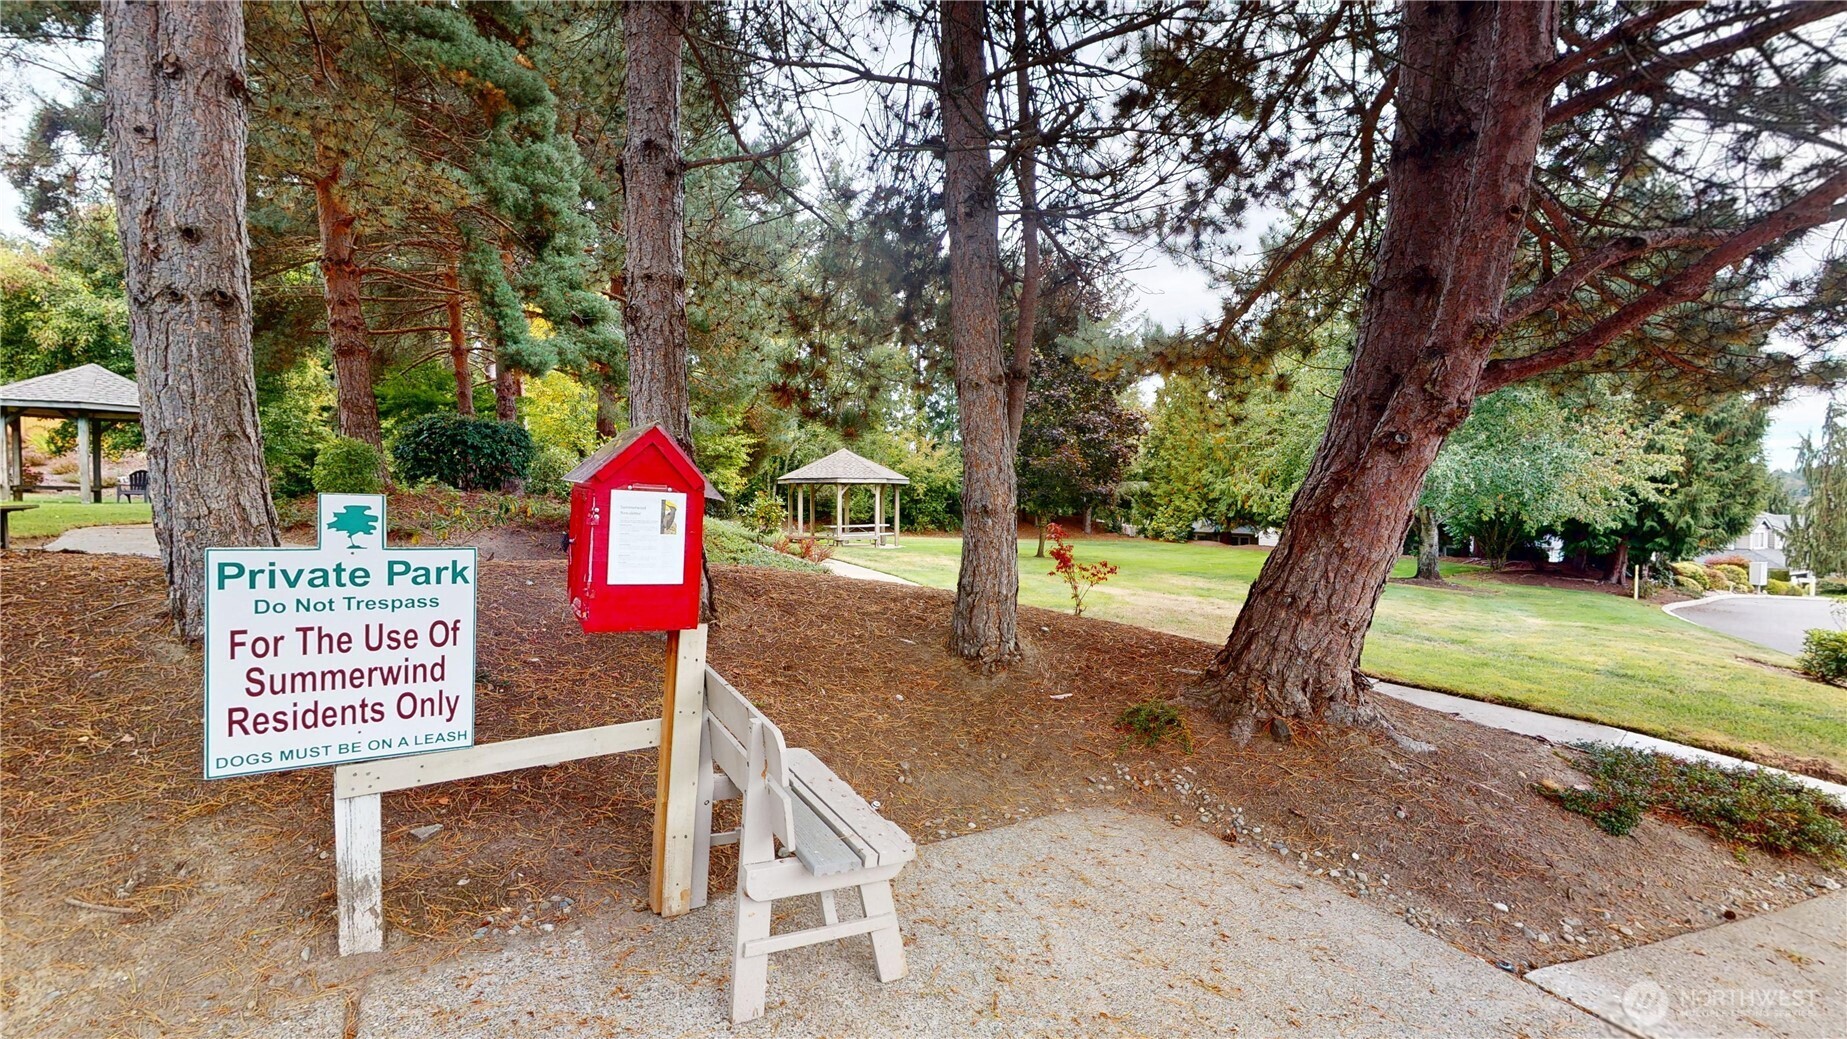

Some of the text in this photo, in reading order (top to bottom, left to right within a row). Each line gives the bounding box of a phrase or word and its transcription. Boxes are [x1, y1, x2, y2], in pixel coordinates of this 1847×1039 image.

[217, 560, 470, 590] Private Park
[254, 596, 440, 615] Do Not Trespass
[229, 619, 461, 660] For The Use Of
[245, 655, 446, 697] Summerwind
[227, 690, 460, 737] Residents Only
[215, 730, 468, 770] DOGS MUST BE ON A LEASH
